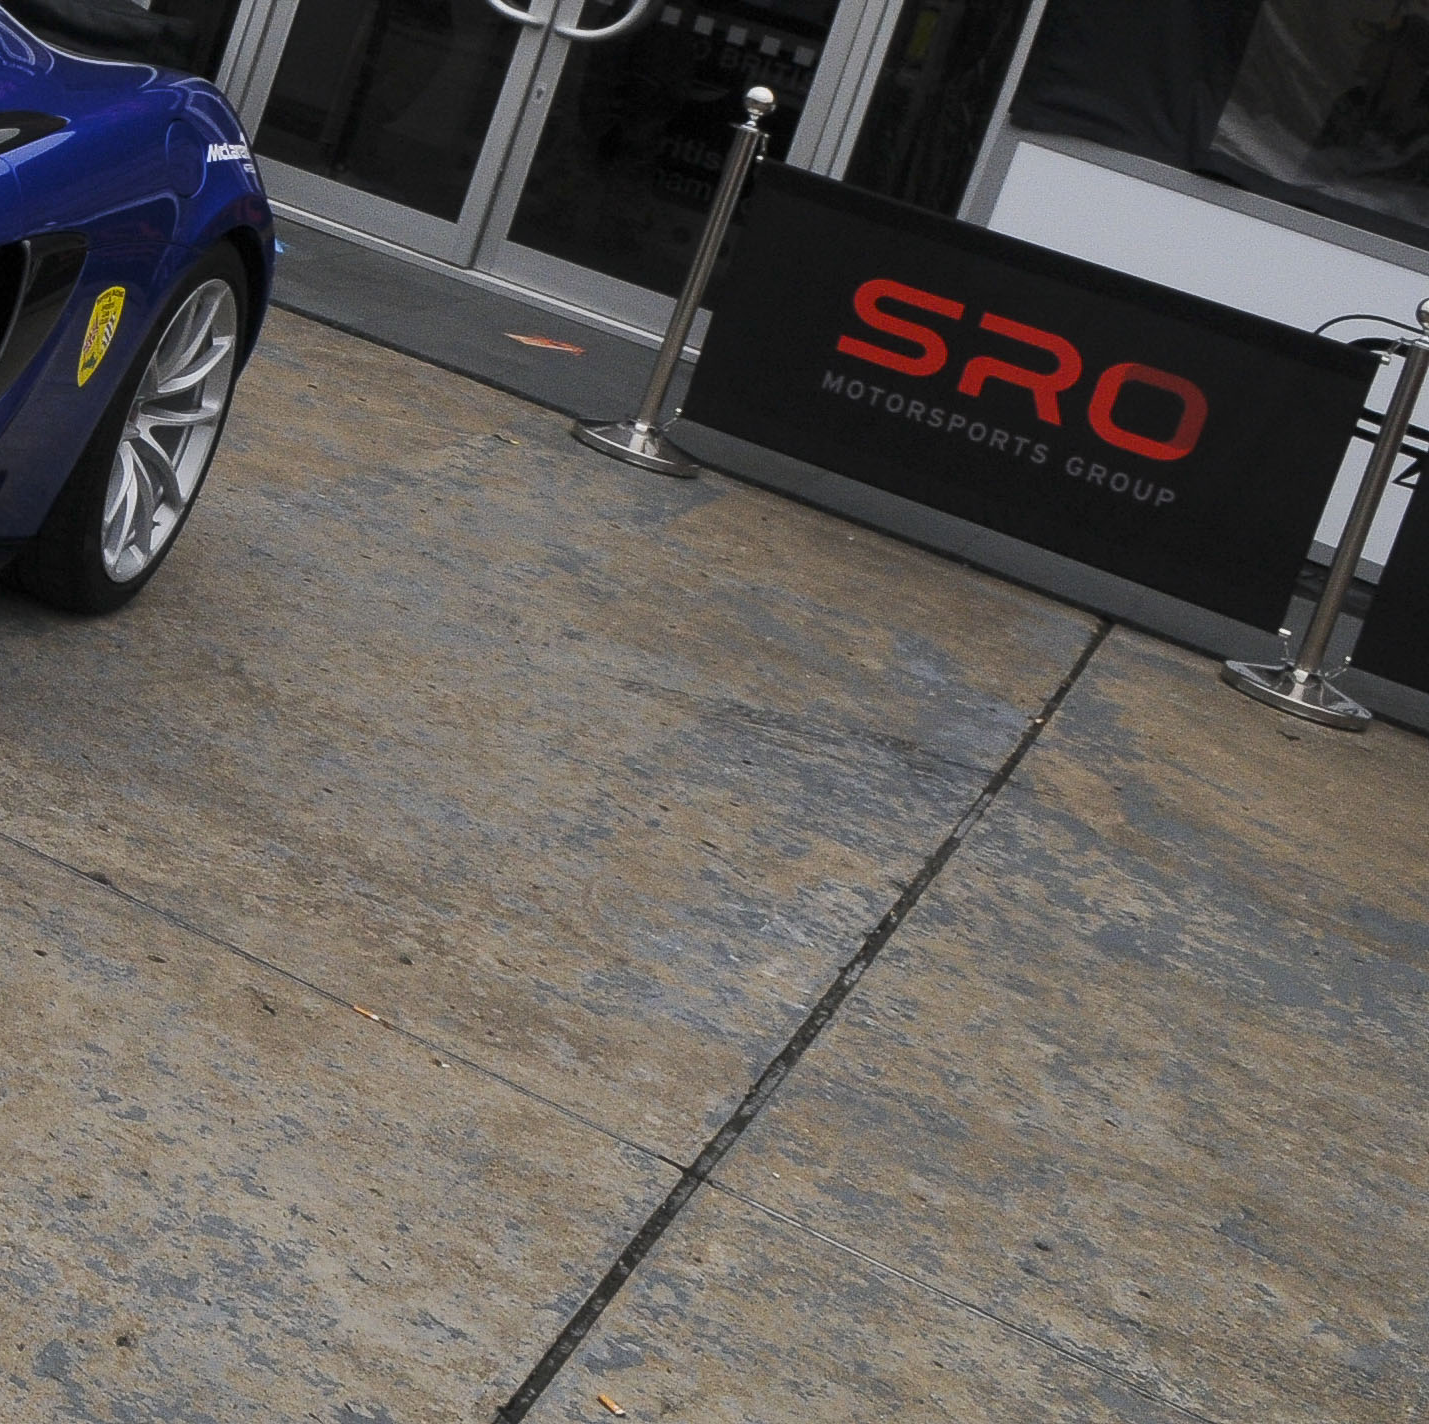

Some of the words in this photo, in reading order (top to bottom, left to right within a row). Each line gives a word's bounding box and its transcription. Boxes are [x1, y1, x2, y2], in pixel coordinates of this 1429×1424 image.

[821, 369, 1049, 465] MOTORSPORTS
[1065, 456, 1177, 509] GROUP
[835, 278, 1210, 462] SRO
